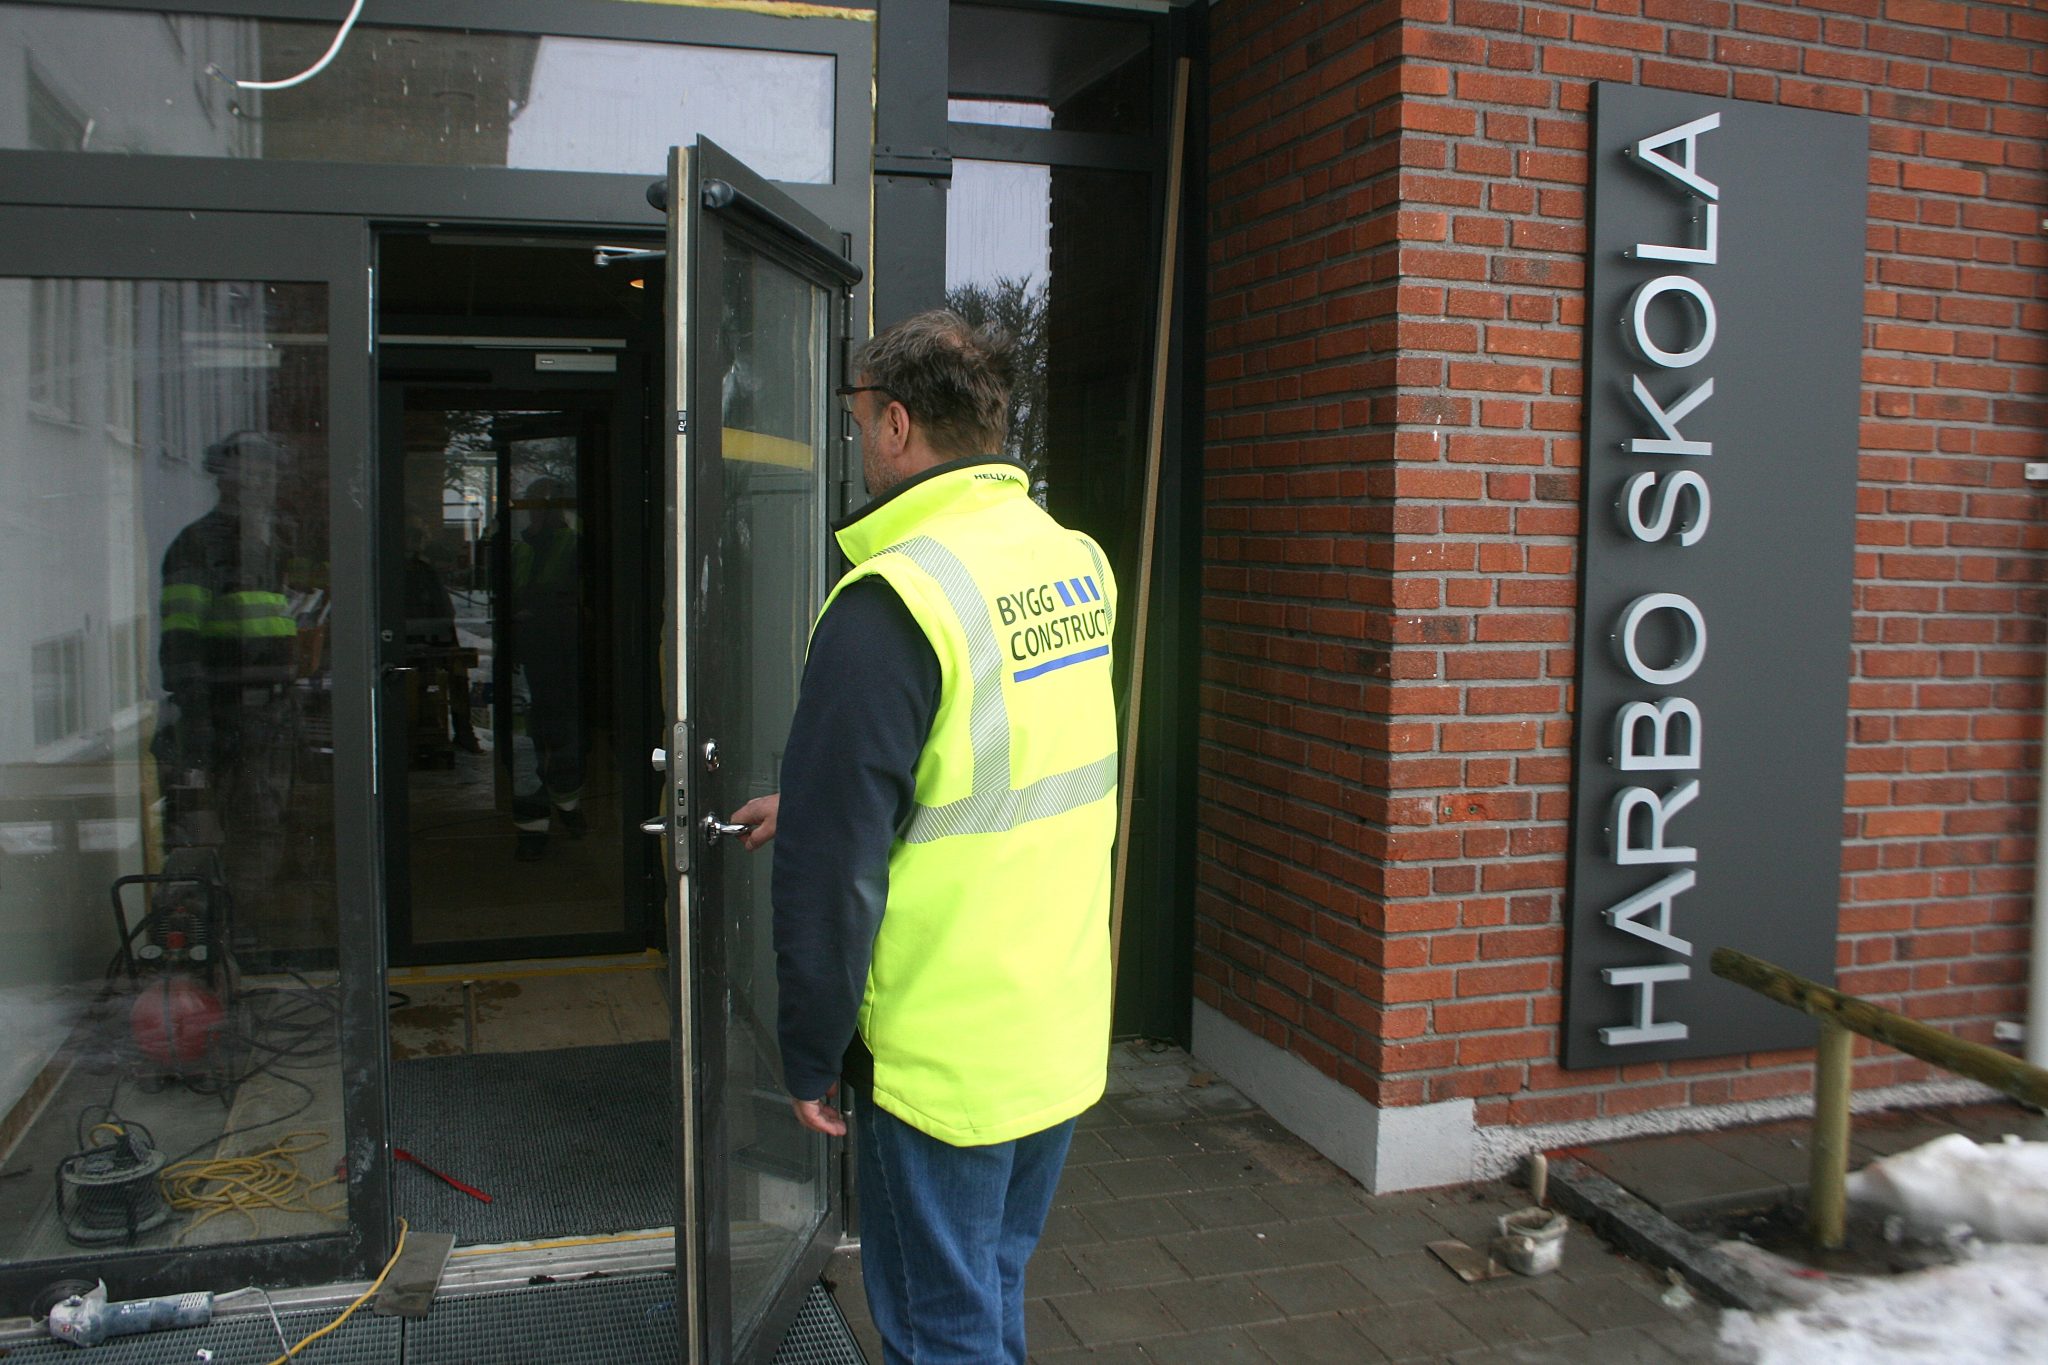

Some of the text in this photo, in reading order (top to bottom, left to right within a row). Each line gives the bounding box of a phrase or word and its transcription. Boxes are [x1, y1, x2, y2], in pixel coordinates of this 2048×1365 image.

[974, 473, 1007, 481] HELLY
[1601, 111, 1721, 1046] HARBO SKOLA
[996, 584, 1055, 626] BYGG
